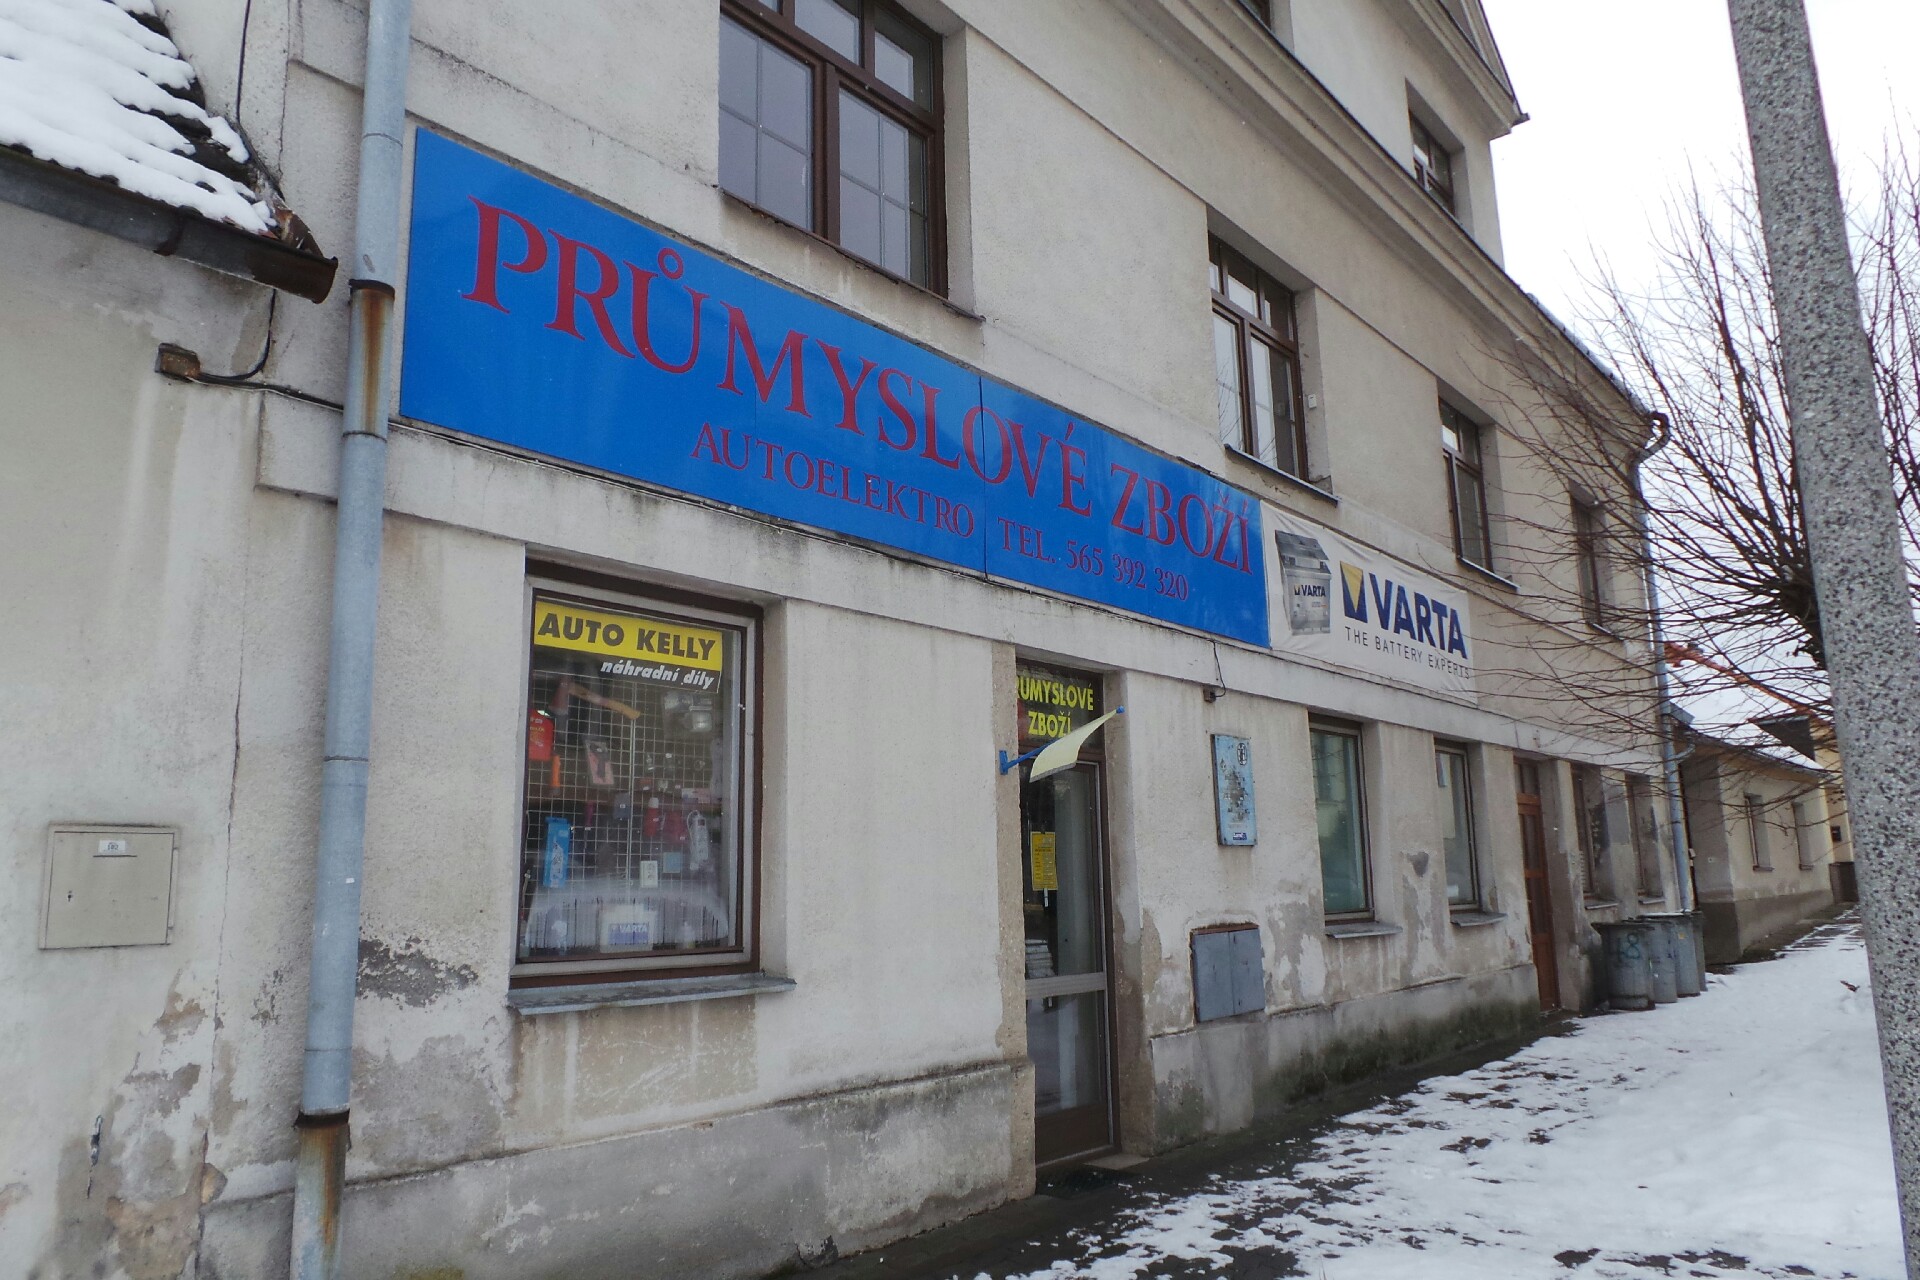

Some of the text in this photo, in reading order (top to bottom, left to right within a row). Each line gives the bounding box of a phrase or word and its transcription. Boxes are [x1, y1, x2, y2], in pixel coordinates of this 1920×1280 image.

[462, 195, 1252, 575] PRŮMYSLOVÉ ZBOŽÍ
[690, 422, 1189, 600] AUTOELEKTRO TEL. 565 392 320
[1301, 584, 1326, 597] VARTA
[538, 612, 716, 661] AUTO KELLY
[1369, 573, 1468, 660] VARTA
[600, 659, 715, 690] náhradní díly
[1345, 626, 1470, 680] THE BATTERY EXPERTS
[1028, 711, 1071, 737] ZBOŽÍ
